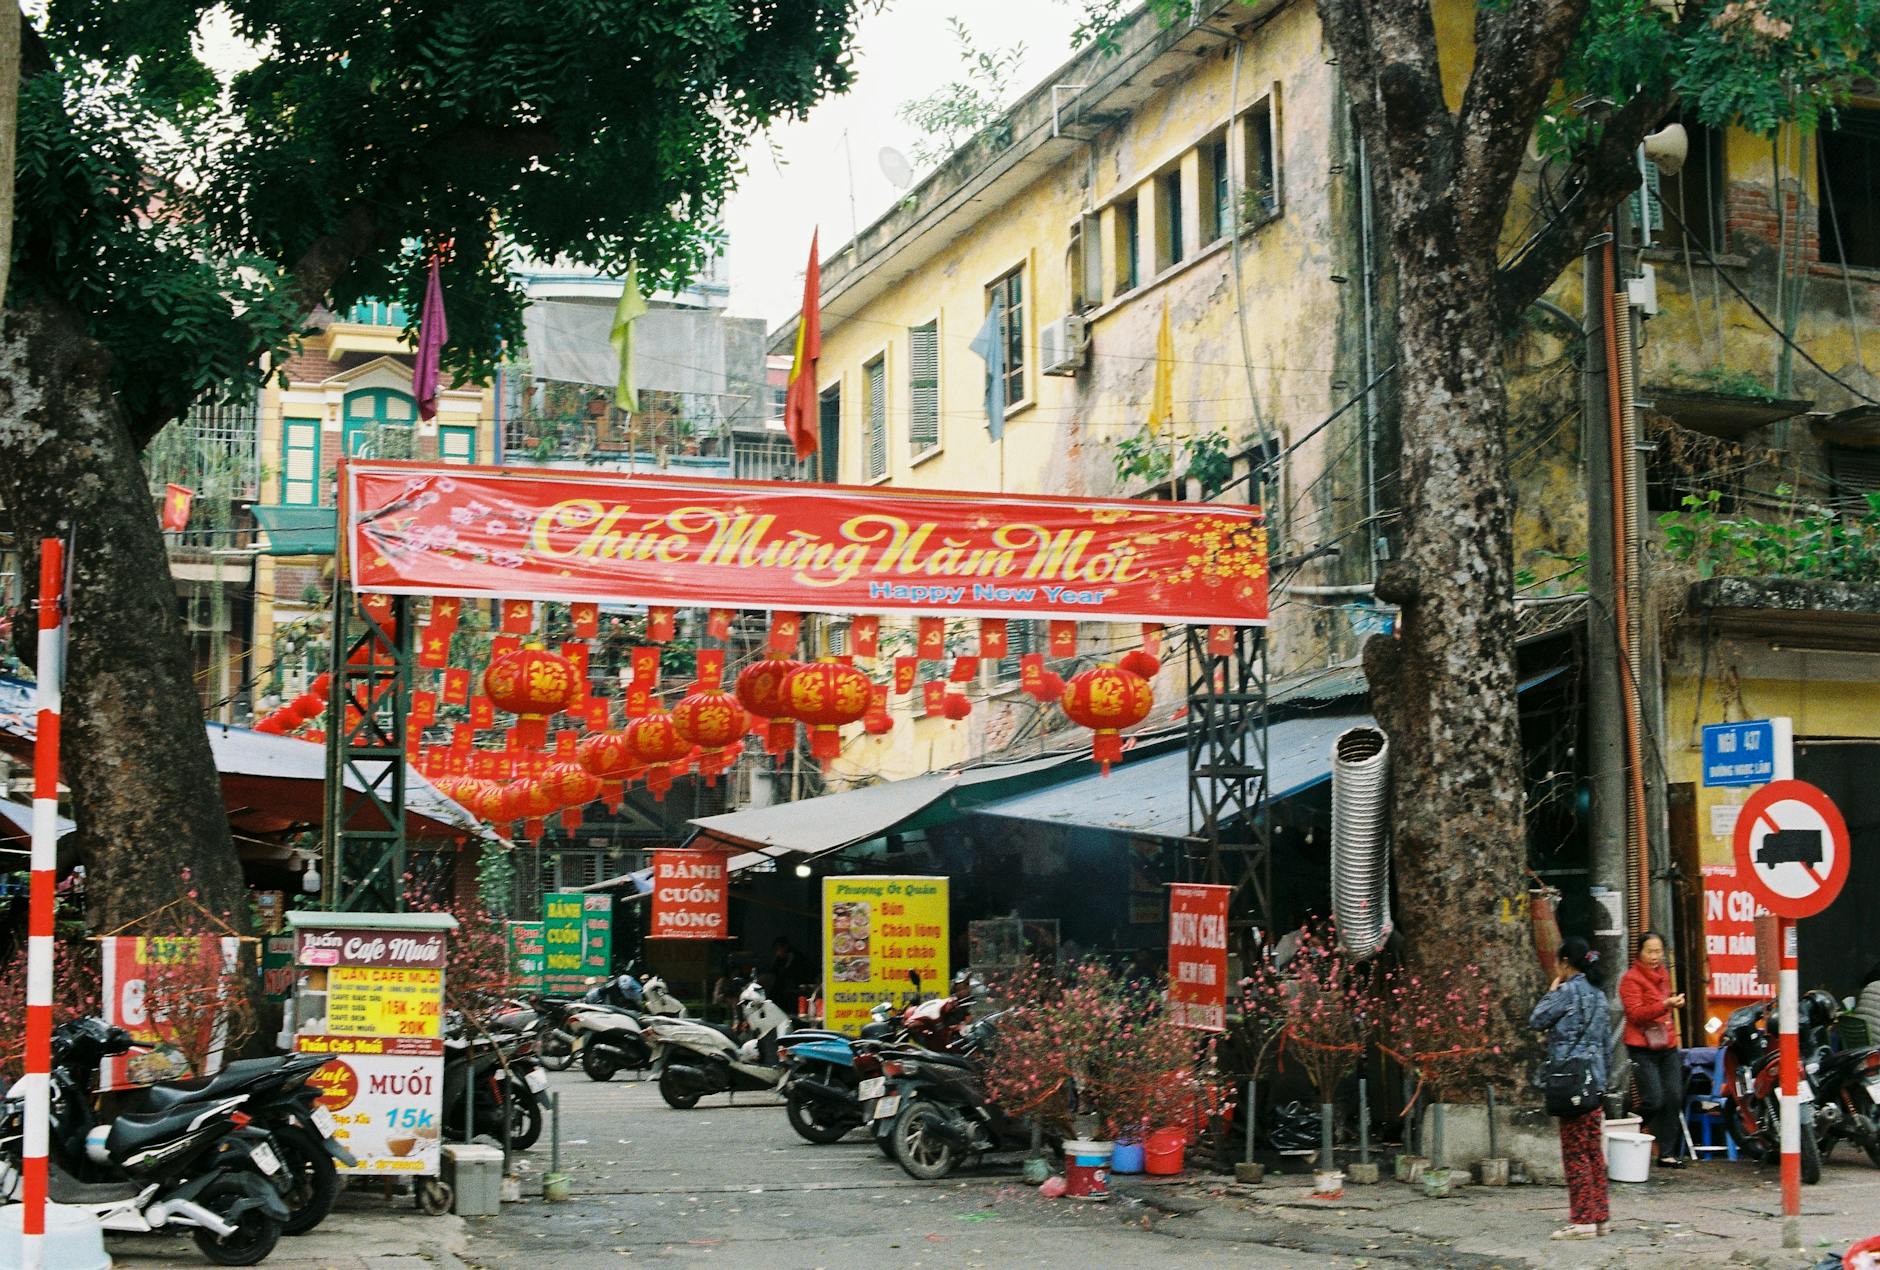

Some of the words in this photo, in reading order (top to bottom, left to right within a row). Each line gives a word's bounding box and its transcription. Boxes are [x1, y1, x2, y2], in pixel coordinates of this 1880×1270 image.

[531, 498, 689, 562] Chúc
[666, 505, 872, 588] Mừng
[839, 514, 1017, 578] Năm
[993, 523, 1149, 583] Mới
[869, 582, 965, 605] Happy
[973, 584, 1036, 603] New
[1040, 586, 1107, 605] Year
[659, 860, 721, 879] BÁNH
[658, 883, 721, 903] CUỐN
[658, 908, 722, 927] NÓNG
[369, 1066, 432, 1095] MUỐI
[386, 1107, 433, 1128] 15k
